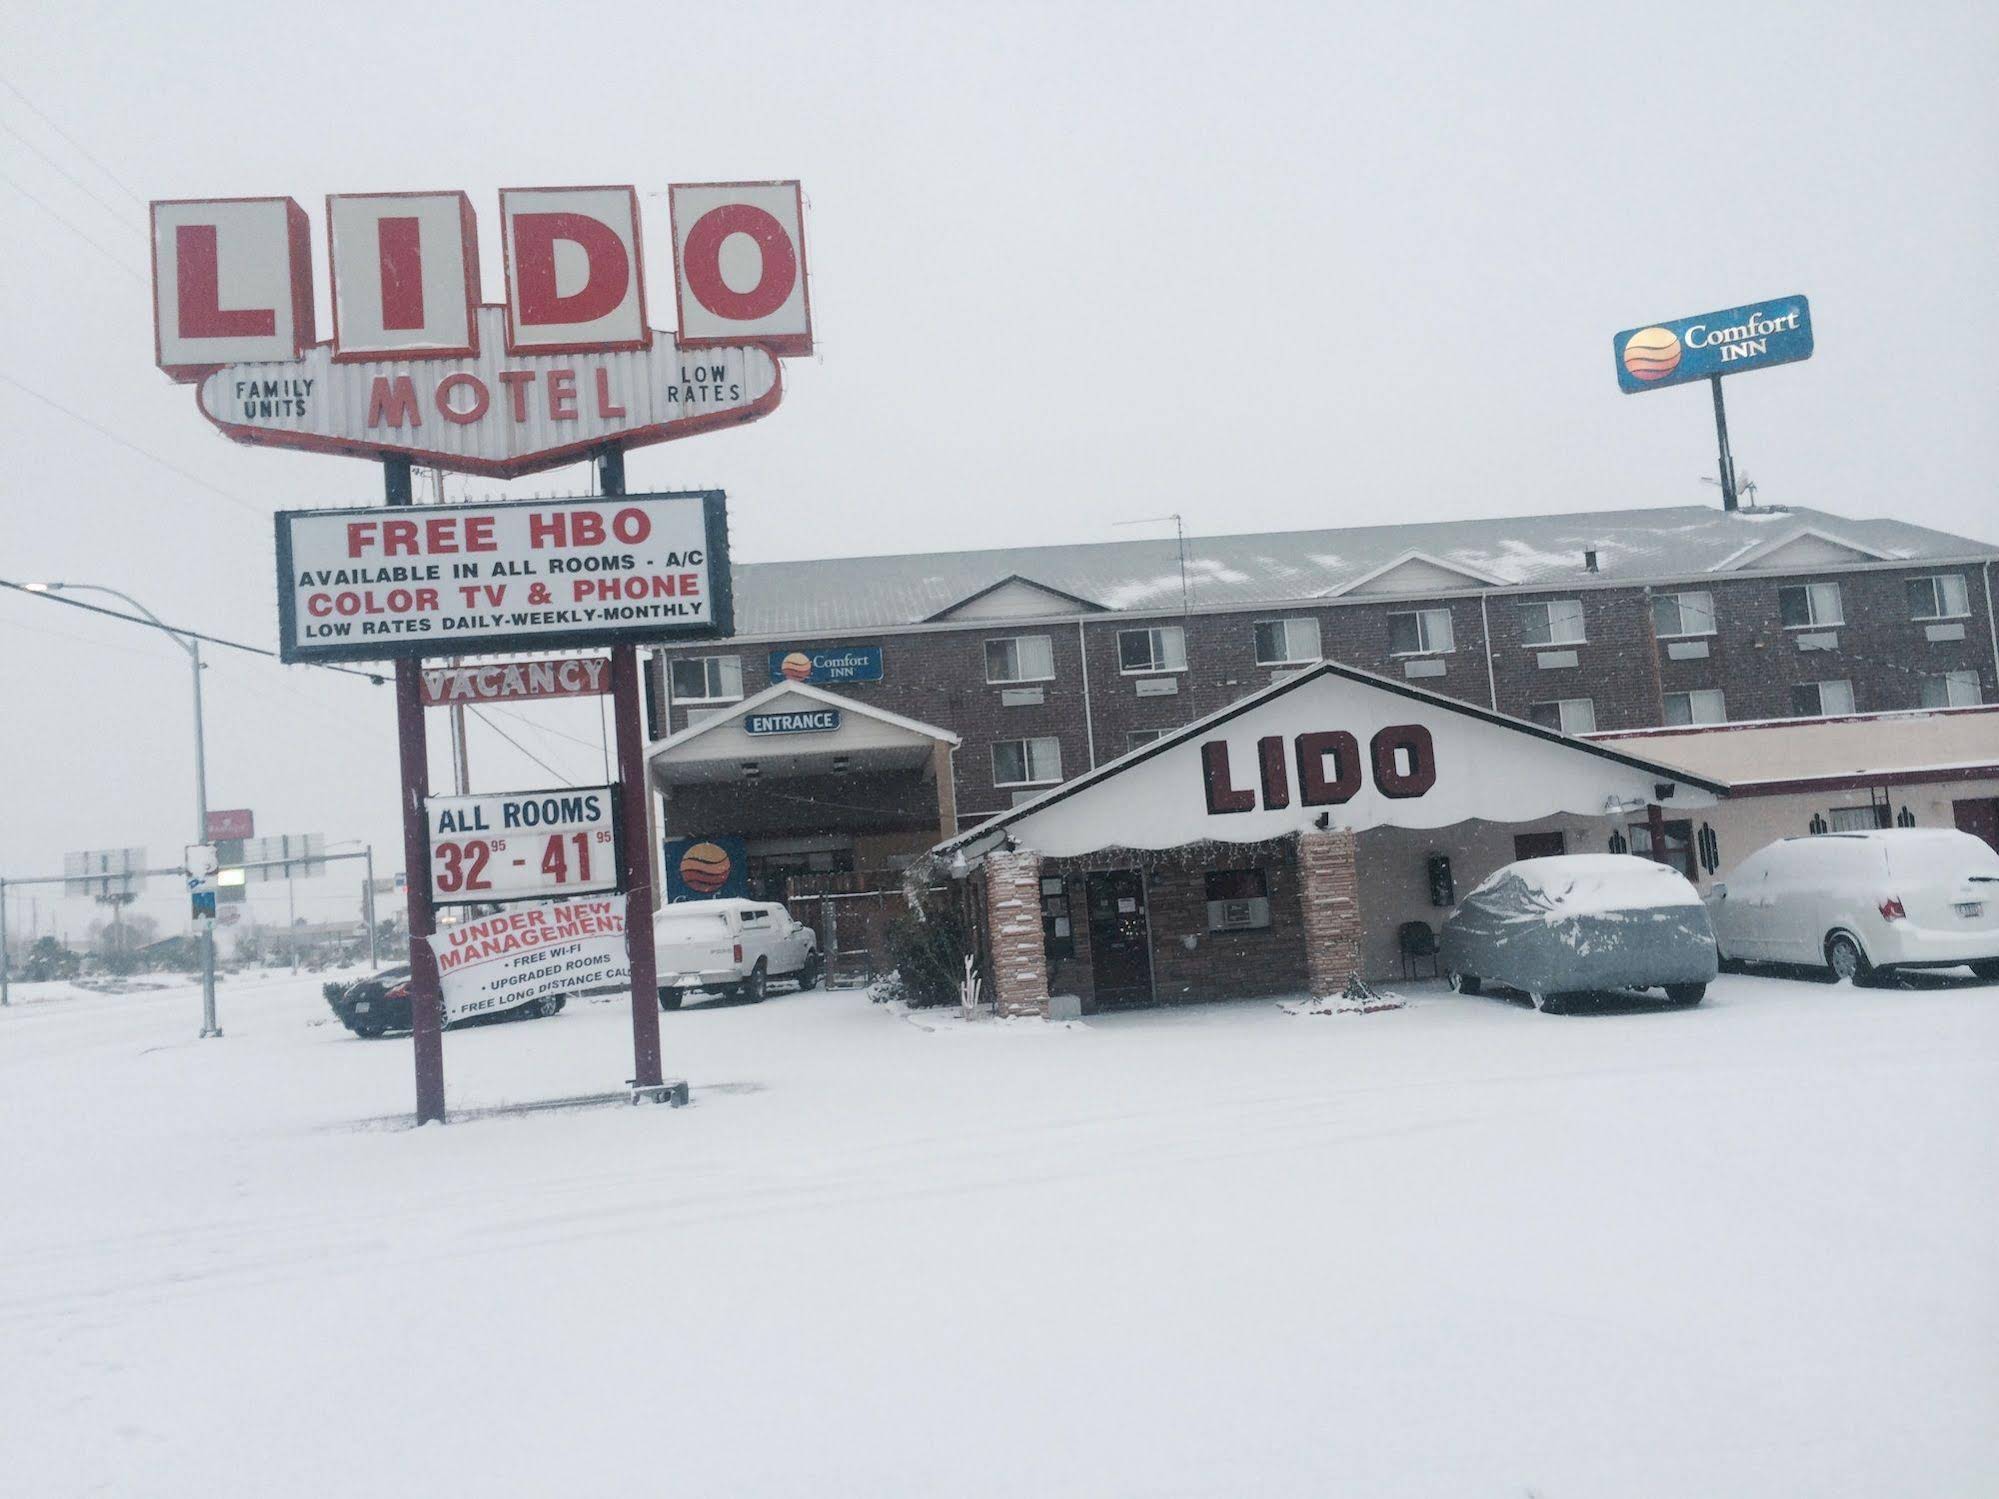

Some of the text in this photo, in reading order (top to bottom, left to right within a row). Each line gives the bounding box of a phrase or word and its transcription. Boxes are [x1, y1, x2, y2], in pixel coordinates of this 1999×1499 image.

[176, 204, 797, 338] LIDO
[1684, 311, 1800, 350] Comfort
[1719, 338, 1768, 363] INN
[235, 378, 315, 400] FAMILY
[667, 383, 741, 403] RATES
[680, 364, 727, 384] LOW
[243, 399, 307, 419] UNITS
[368, 368, 627, 428] MOTEL
[347, 507, 652, 559] FREE HBO
[299, 564, 441, 587] AVAILABLE
[453, 562, 479, 579] IN
[491, 560, 537, 577] ALL
[549, 554, 636, 574] ROOMS
[666, 550, 704, 568] A/C
[307, 573, 700, 618] COLOR TV & PHONE
[306, 622, 352, 638] LOW
[362, 618, 432, 635] RATES
[422, 659, 605, 700] VACANCY
[813, 652, 869, 669] Comfort
[830, 667, 854, 678] INN
[753, 711, 834, 733] ENTRANCE
[1201, 724, 1436, 815] LIDO
[438, 795, 602, 834] ALL ROOMS
[440, 915, 625, 971] MANAGEMENT
[449, 901, 611, 947] UNDER NEW
[491, 953, 612, 991] UPGRADED ROOMS
[513, 943, 582, 968] FREE WI-FI
[460, 997, 496, 1014] FREE
[499, 987, 535, 1006] LONG
[538, 971, 602, 993] DISTANCE
